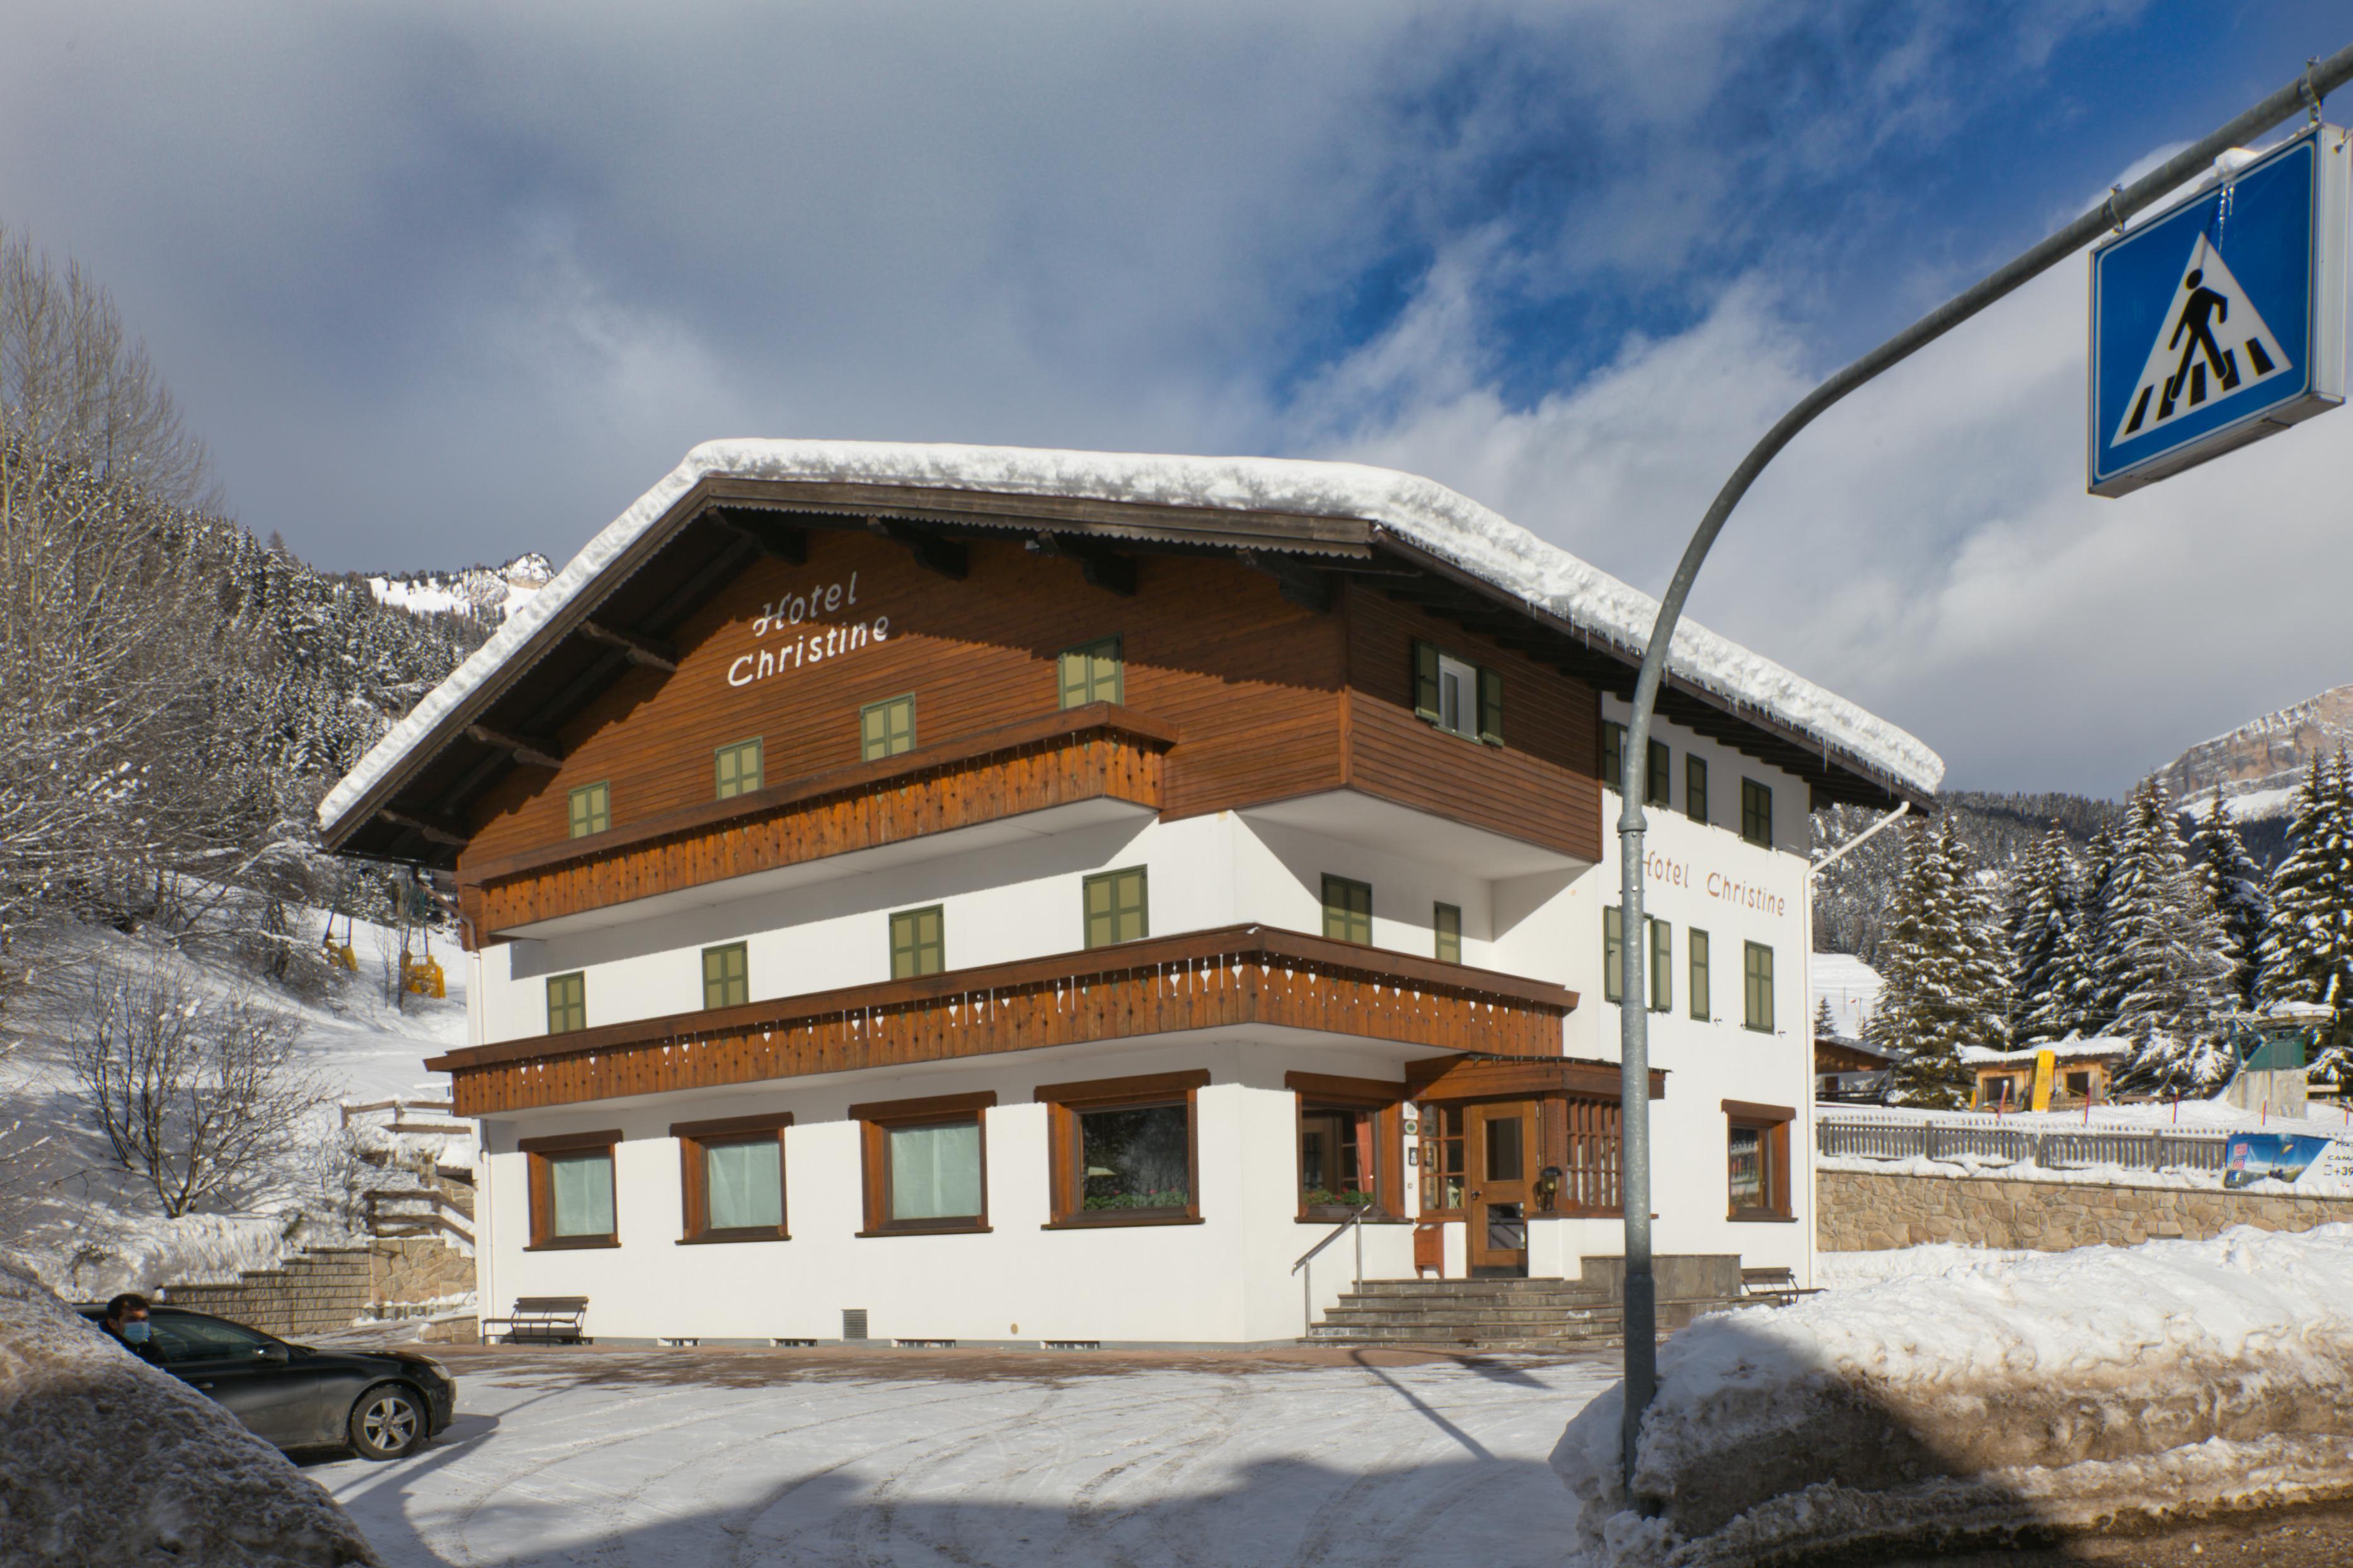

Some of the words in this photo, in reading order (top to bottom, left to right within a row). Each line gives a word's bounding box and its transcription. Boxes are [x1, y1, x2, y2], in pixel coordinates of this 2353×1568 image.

[752, 571, 857, 637] Hotel
[727, 615, 889, 687] Christine
[1707, 872, 1785, 917] Christine
